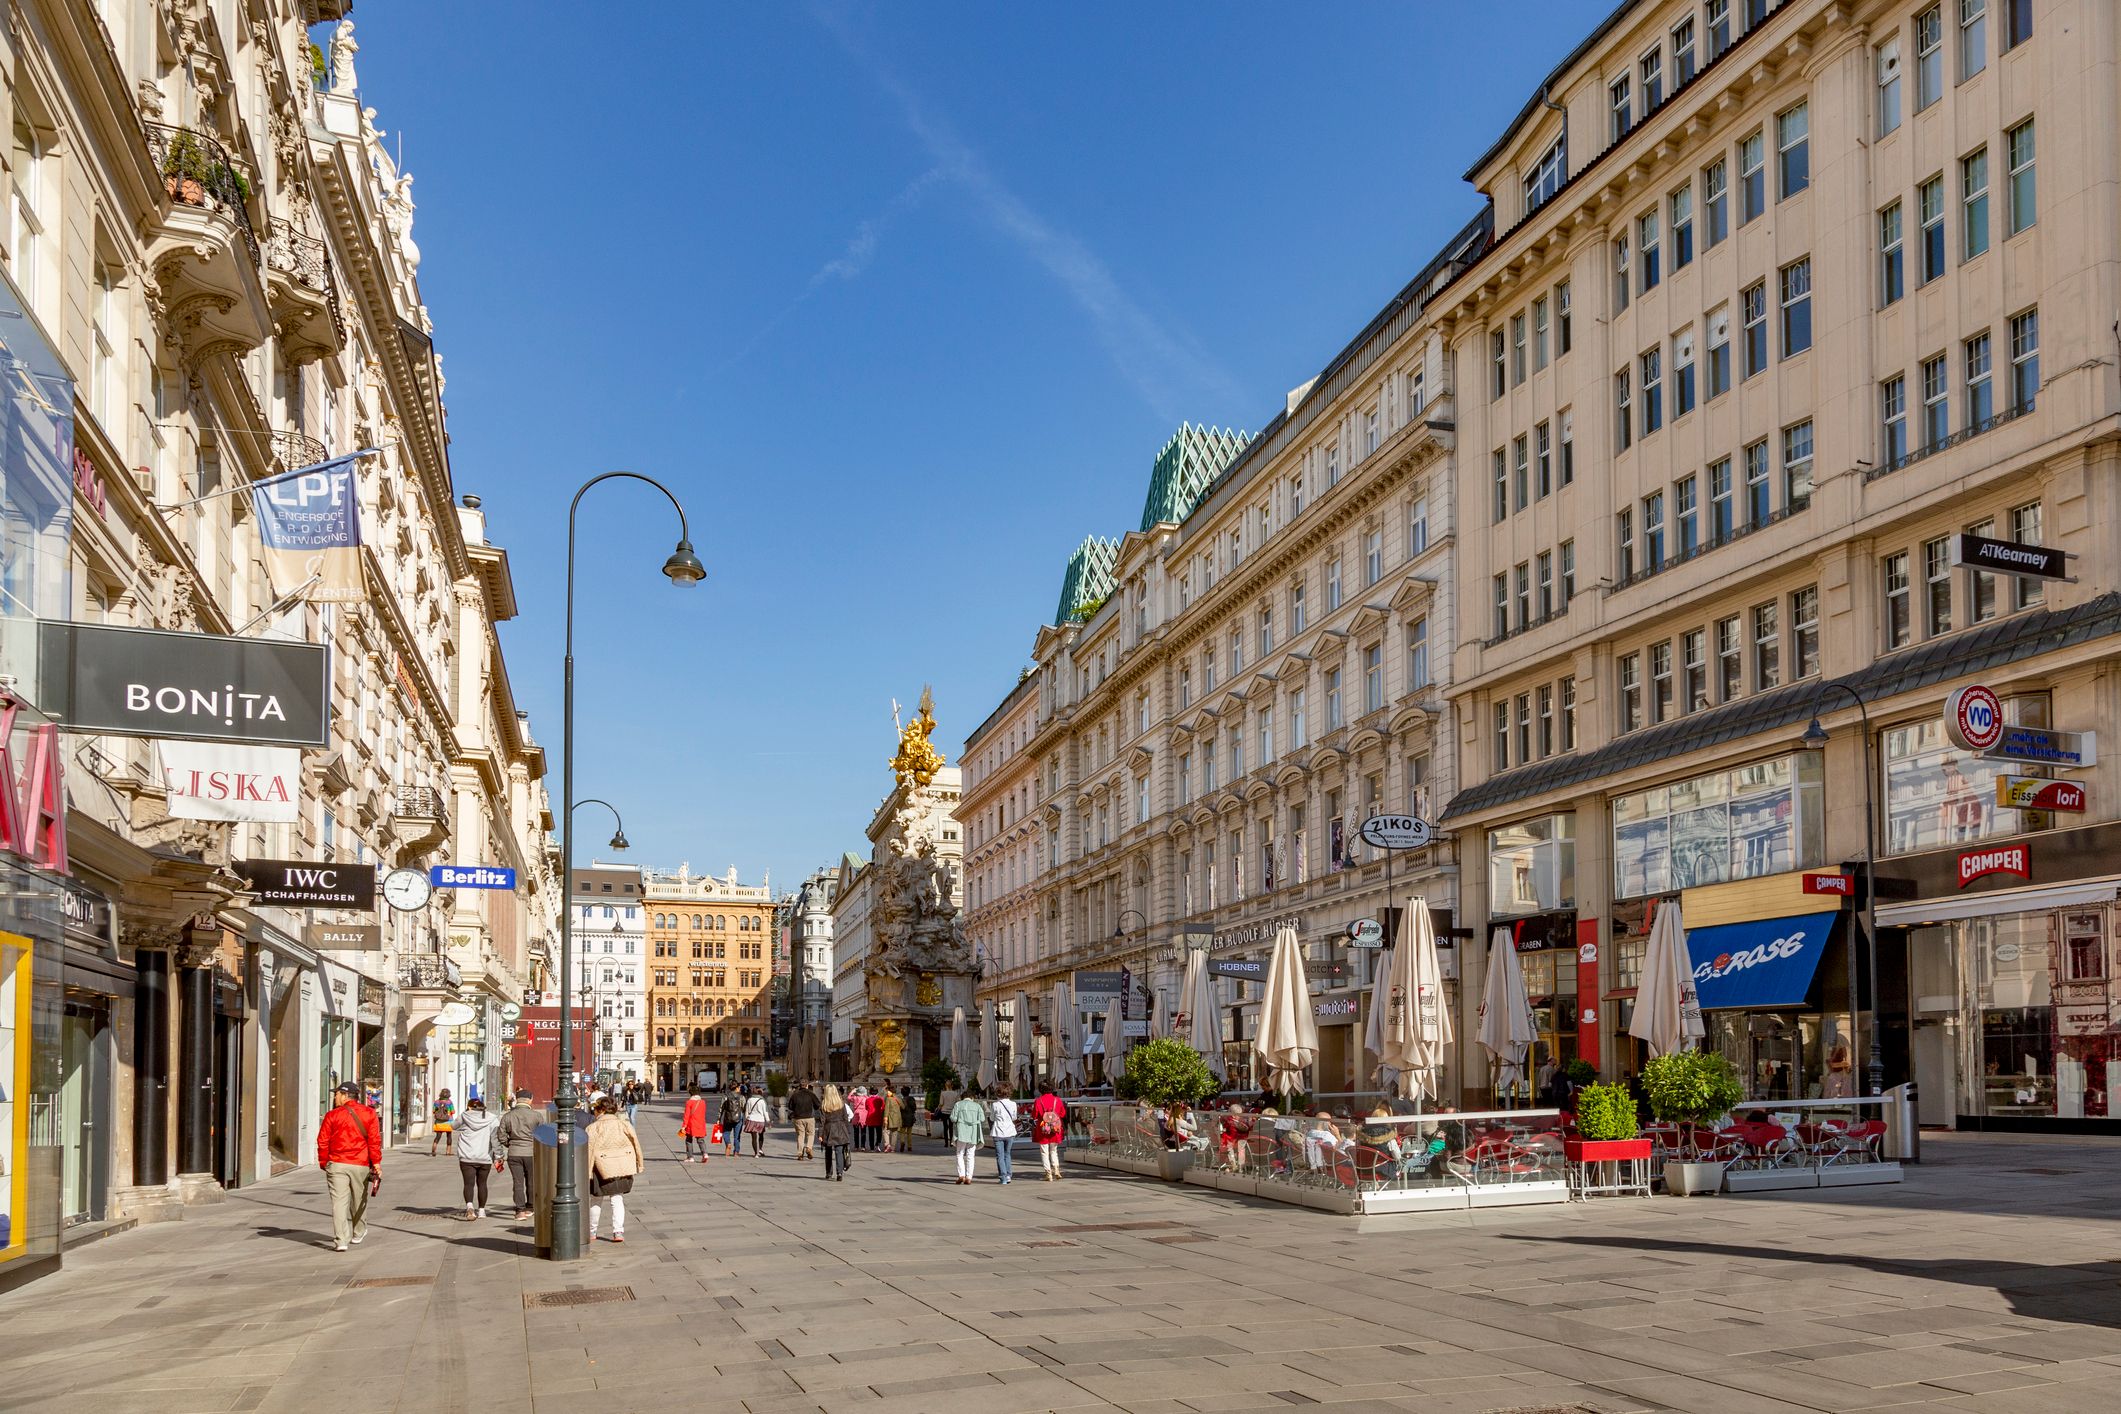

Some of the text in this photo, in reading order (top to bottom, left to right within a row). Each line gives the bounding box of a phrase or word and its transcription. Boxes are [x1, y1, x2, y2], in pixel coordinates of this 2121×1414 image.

[1371, 818, 1423, 833] ZIKOS
[1961, 849, 2023, 878] CAMPER
[284, 868, 337, 889] IWC
[442, 869, 507, 885] Berlitz
[1816, 877, 1846, 891] CAMPER
[265, 891, 355, 902] SCHAFFHAUSEN
[323, 933, 365, 942] BALLY
[1226, 927, 1260, 948] RUDOLF
[1315, 999, 1350, 1016] swatch
